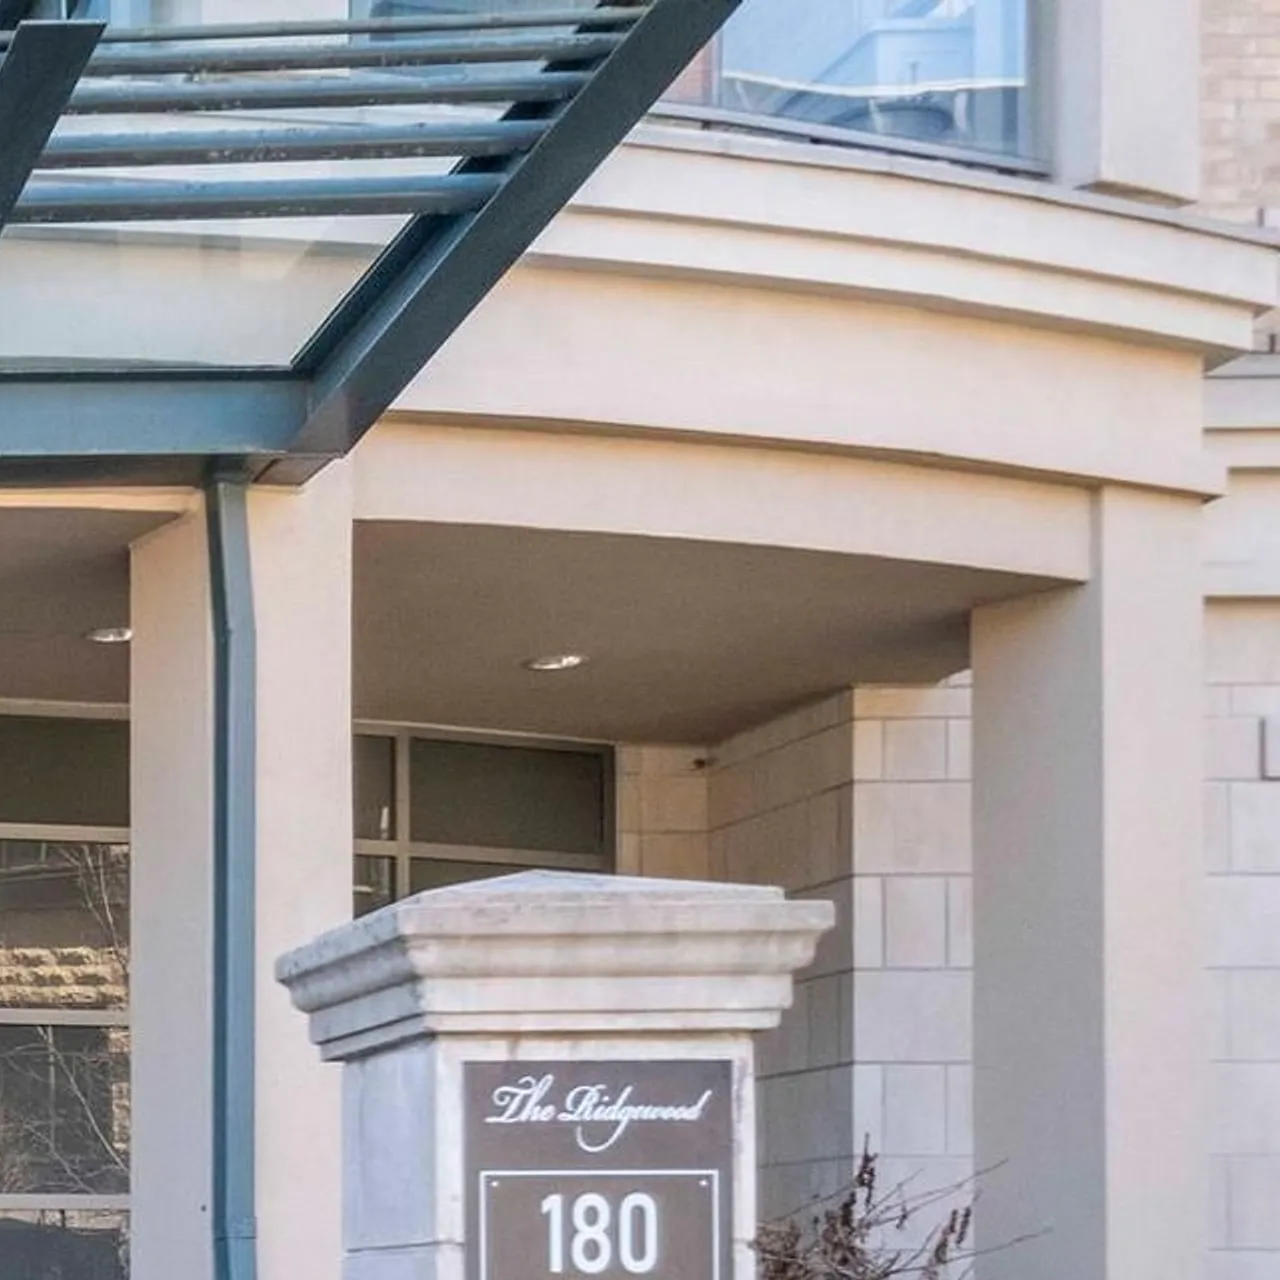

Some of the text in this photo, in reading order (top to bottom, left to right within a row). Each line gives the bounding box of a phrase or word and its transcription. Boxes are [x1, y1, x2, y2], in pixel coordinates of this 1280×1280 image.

[484, 1074, 712, 1153] The Ridgewood
[540, 1192, 659, 1274] 180
